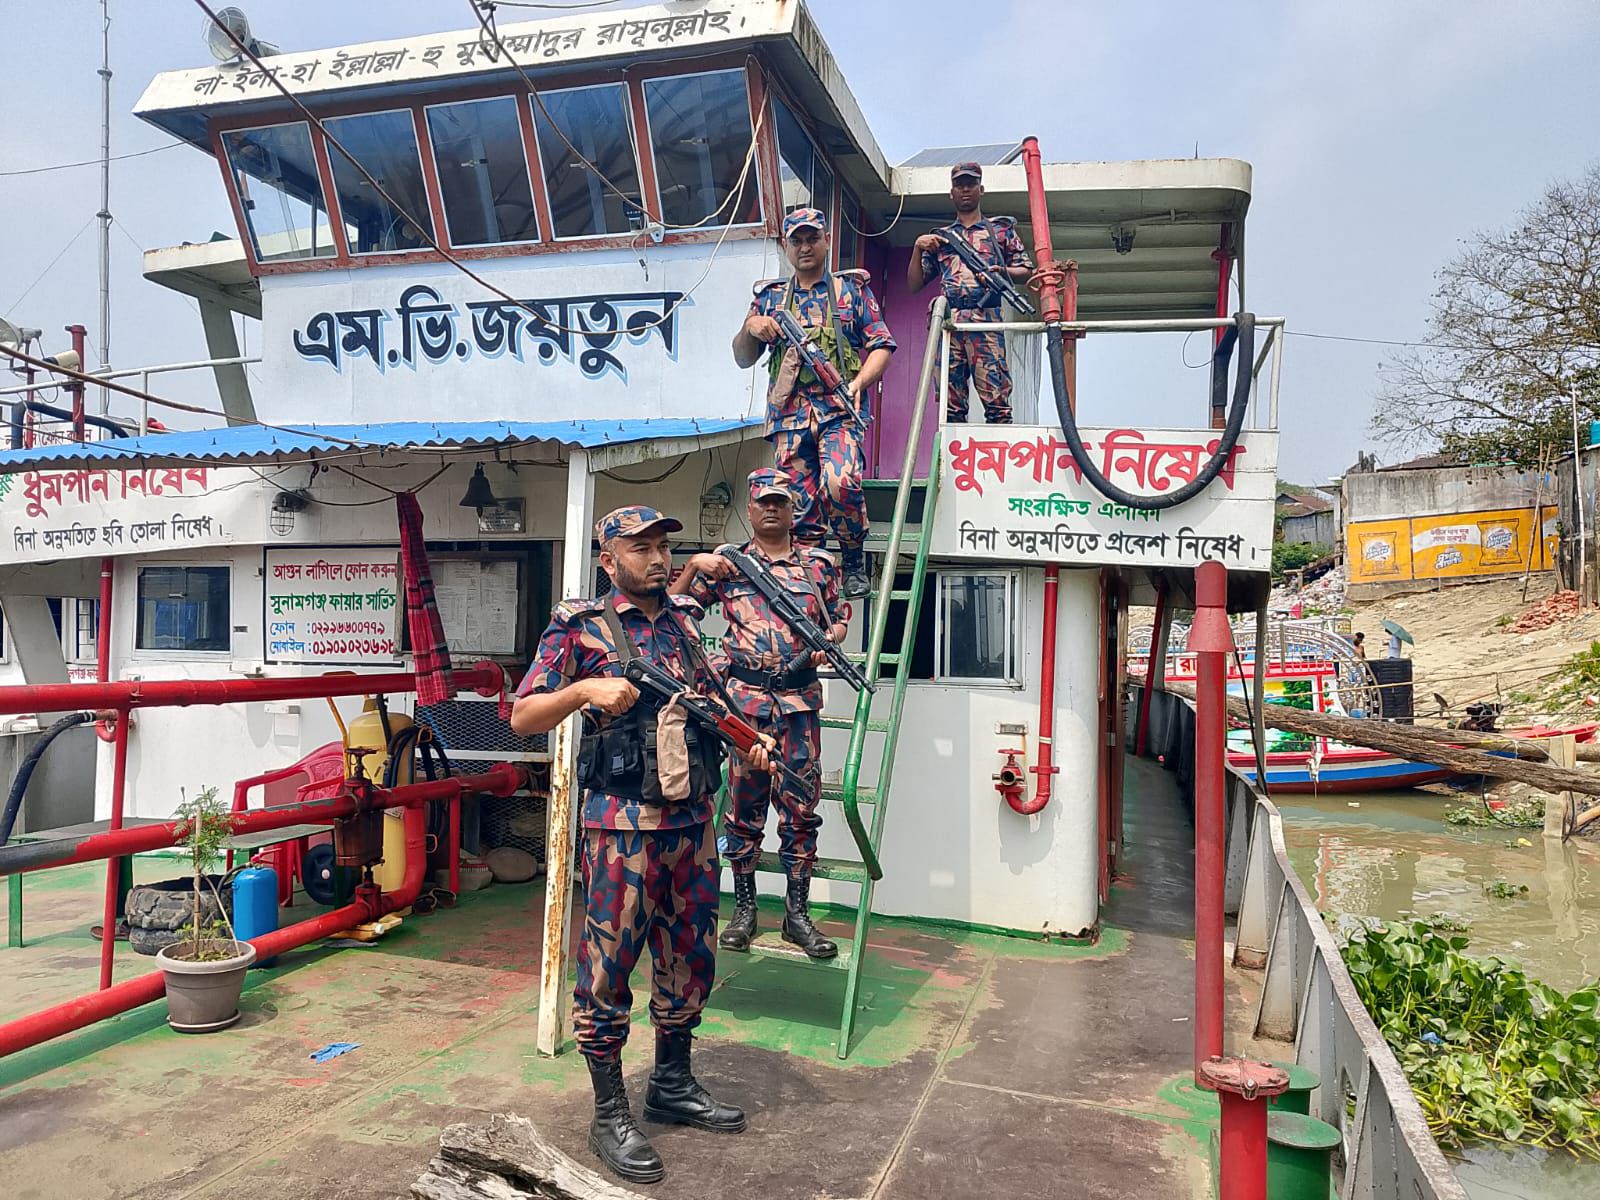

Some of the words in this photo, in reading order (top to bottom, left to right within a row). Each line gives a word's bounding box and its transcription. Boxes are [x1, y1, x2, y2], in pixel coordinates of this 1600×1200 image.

[948, 436, 1092, 498] ধুমপান
[1008, 493, 1092, 519] সংরক্ষিত
[14, 526, 37, 551] বিনা
[43, 522, 97, 552] অনুমতিতে
[102, 519, 125, 546] ছবি
[130, 521, 167, 544] তোলা
[171, 513, 213, 541] নিষেধ
[958, 520, 1001, 551] বিনা
[1006, 522, 1103, 557] অনুমতিতে
[1105, 530, 1171, 558] প্রবেশ
[1175, 526, 1245, 560] নিষেধ
[273, 563, 302, 580] আগুন
[305, 559, 343, 581] লাগিলে
[345, 562, 369, 582] ফোন
[371, 563, 398, 579] করুন
[270, 592, 327, 616] সুনামগঞ্জ
[329, 592, 364, 611] ফায়ার
[270, 620, 295, 636] ফোন
[270, 636, 305, 655] মোবাইল
